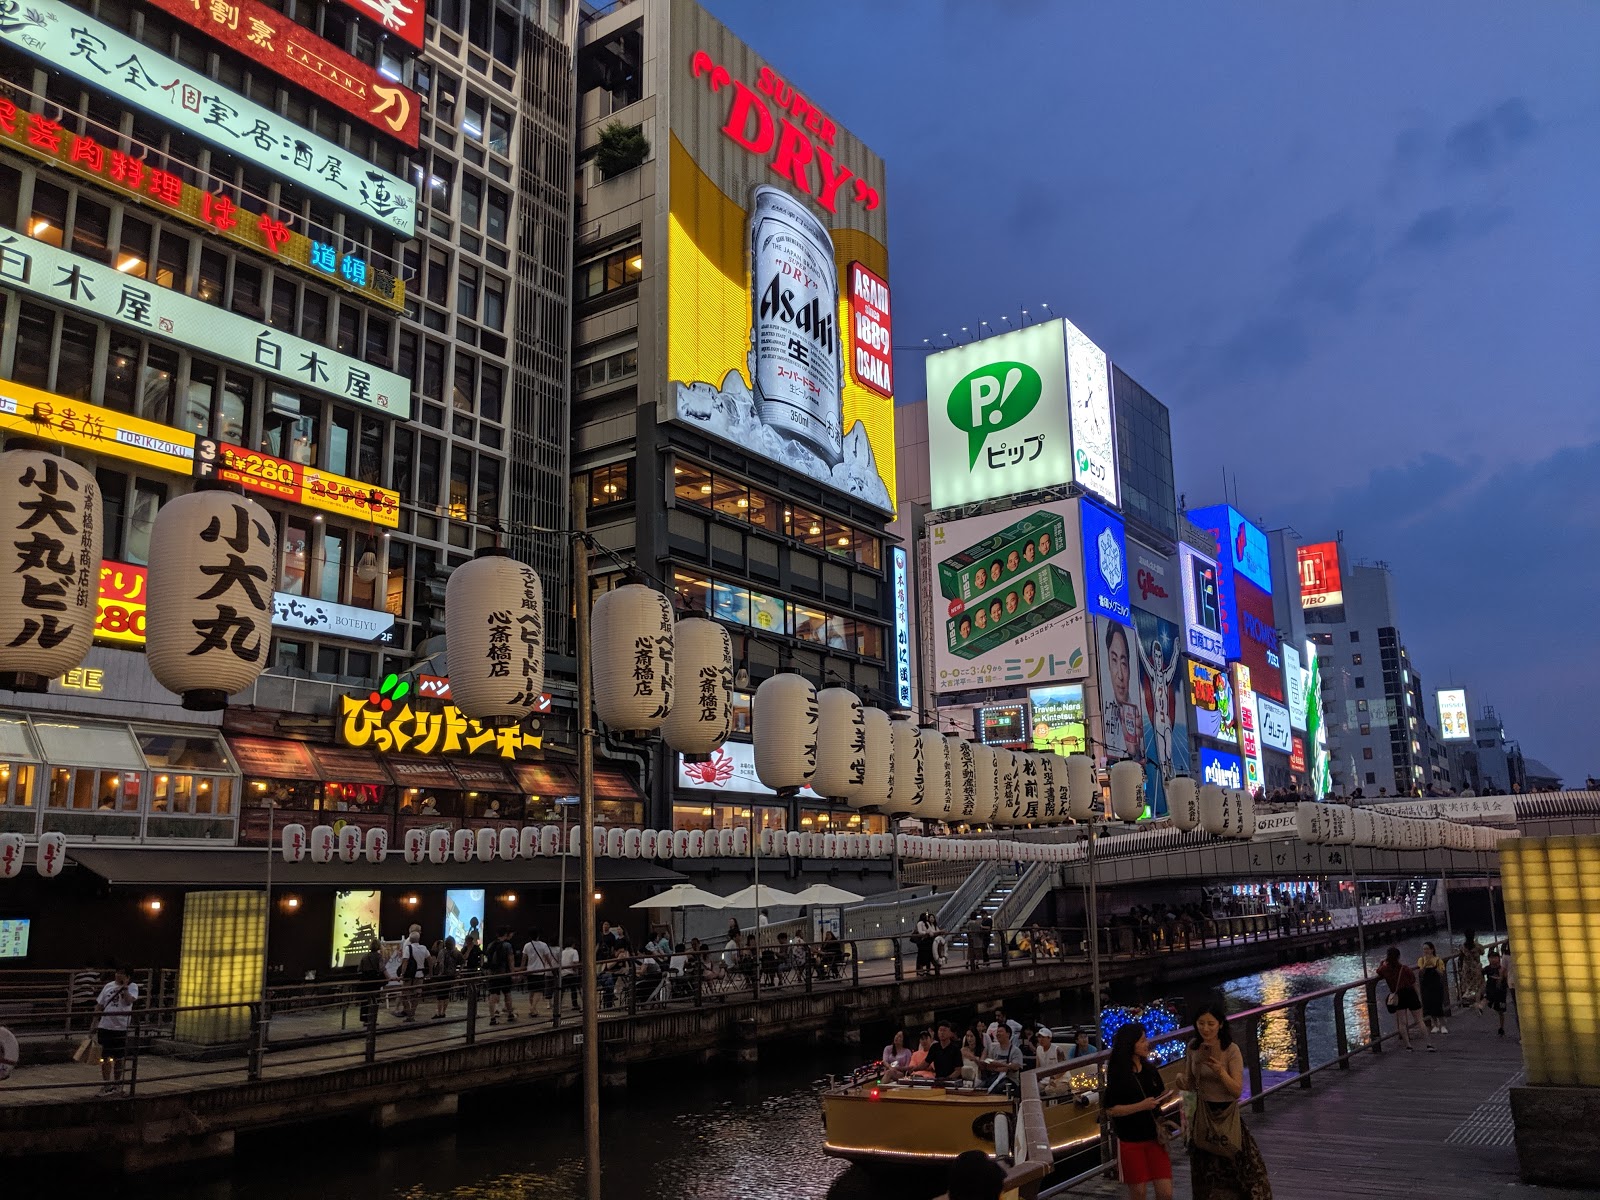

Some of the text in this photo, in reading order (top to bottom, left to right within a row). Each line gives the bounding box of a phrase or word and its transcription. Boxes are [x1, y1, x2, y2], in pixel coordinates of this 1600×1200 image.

[287, 44, 366, 97] KATANA
[69, 27, 348, 191] 完全個室居酒屋
[370, 84, 410, 131] 刀
[758, 66, 837, 147] SUPER
[0, 236, 152, 327] 白木屋
[854, 268, 888, 315] ASAHI
[761, 273, 832, 355] Asahi
[855, 312, 889, 355] 1889
[255, 331, 374, 403] 白木屋
[788, 338, 809, 367] 生
[857, 347, 891, 392] OSAKA
[777, 365, 820, 396] スーパードライ
[119, 429, 186, 457] TORIKIZOKU
[790, 410, 809, 428] 350ml
[987, 433, 1045, 470] ピップ
[5, 459, 79, 649] 小大丸ビル
[76, 483, 94, 608] 心斎橋筋商店街
[186, 503, 271, 662] 小大丸
[335, 616, 377, 631] BOTEJYU
[380, 633, 393, 642] 2F
[507, 567, 542, 707] 子ども服 ベビードール
[656, 594, 672, 634] 子ども服
[1242, 610, 1278, 652] PROMISE
[486, 609, 513, 678] 心斎橋店
[632, 635, 654, 697] 心斎橋店
[1005, 653, 1066, 680] ミント
[698, 664, 719, 723] 心斎橋店
[1033, 705, 1056, 715] Travel
[1063, 703, 1081, 712] Nara
[1041, 713, 1075, 722] Kintetsu.
[341, 694, 543, 760] びっくりドンキー
[909, 727, 925, 806] ツルハドラッグ
[960, 741, 974, 816] 東急不動産株式会社
[1022, 758, 1039, 819] 松前屋
[1188, 800, 1196, 822] 株式会社
